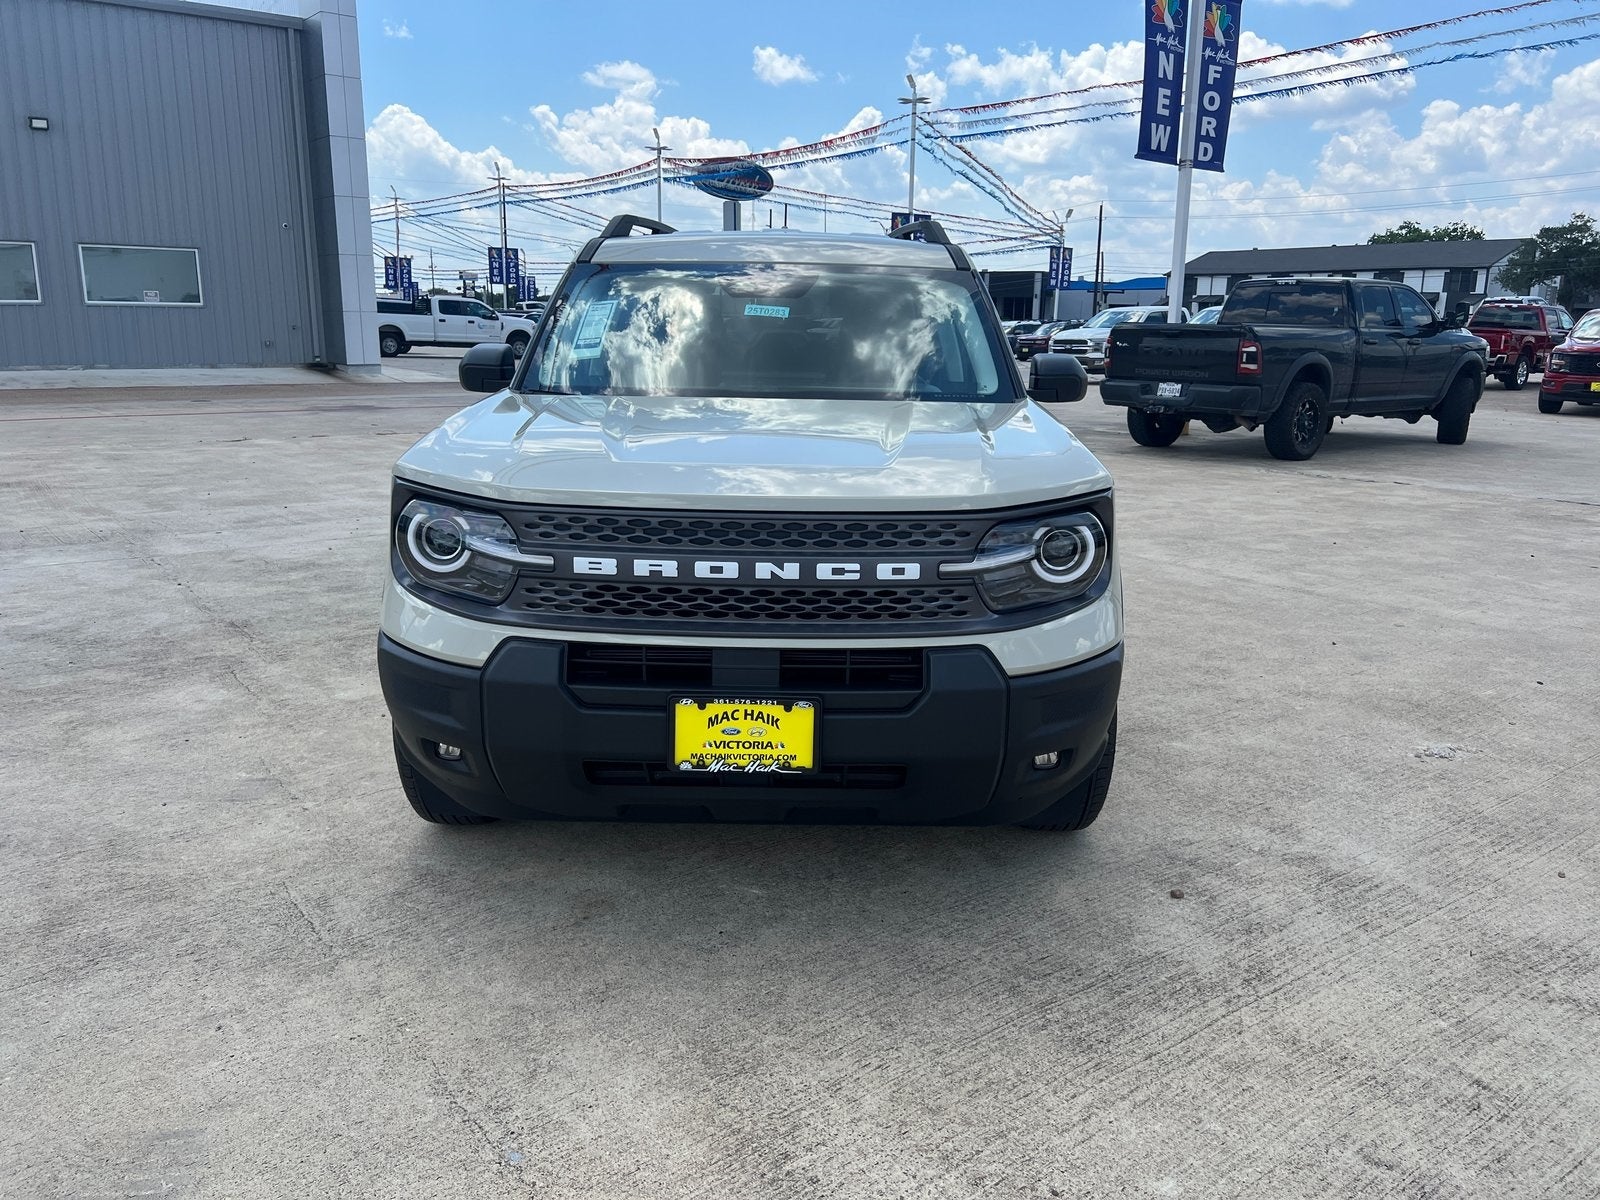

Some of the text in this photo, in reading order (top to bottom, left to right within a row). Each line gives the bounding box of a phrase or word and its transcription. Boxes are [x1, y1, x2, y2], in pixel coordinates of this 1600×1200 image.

[1150, 50, 1174, 152] NEW
[1197, 64, 1223, 162] FORD
[492, 262, 500, 283] NEW
[746, 306, 786, 317] 25T0283
[573, 556, 921, 580] BRONCO
[707, 708, 781, 730] MAC HAIK
[713, 740, 774, 750] VICTORIA
[690, 752, 797, 761] MACHAIKVICTORIA.COM
[706, 759, 785, 774] Mac Haik
